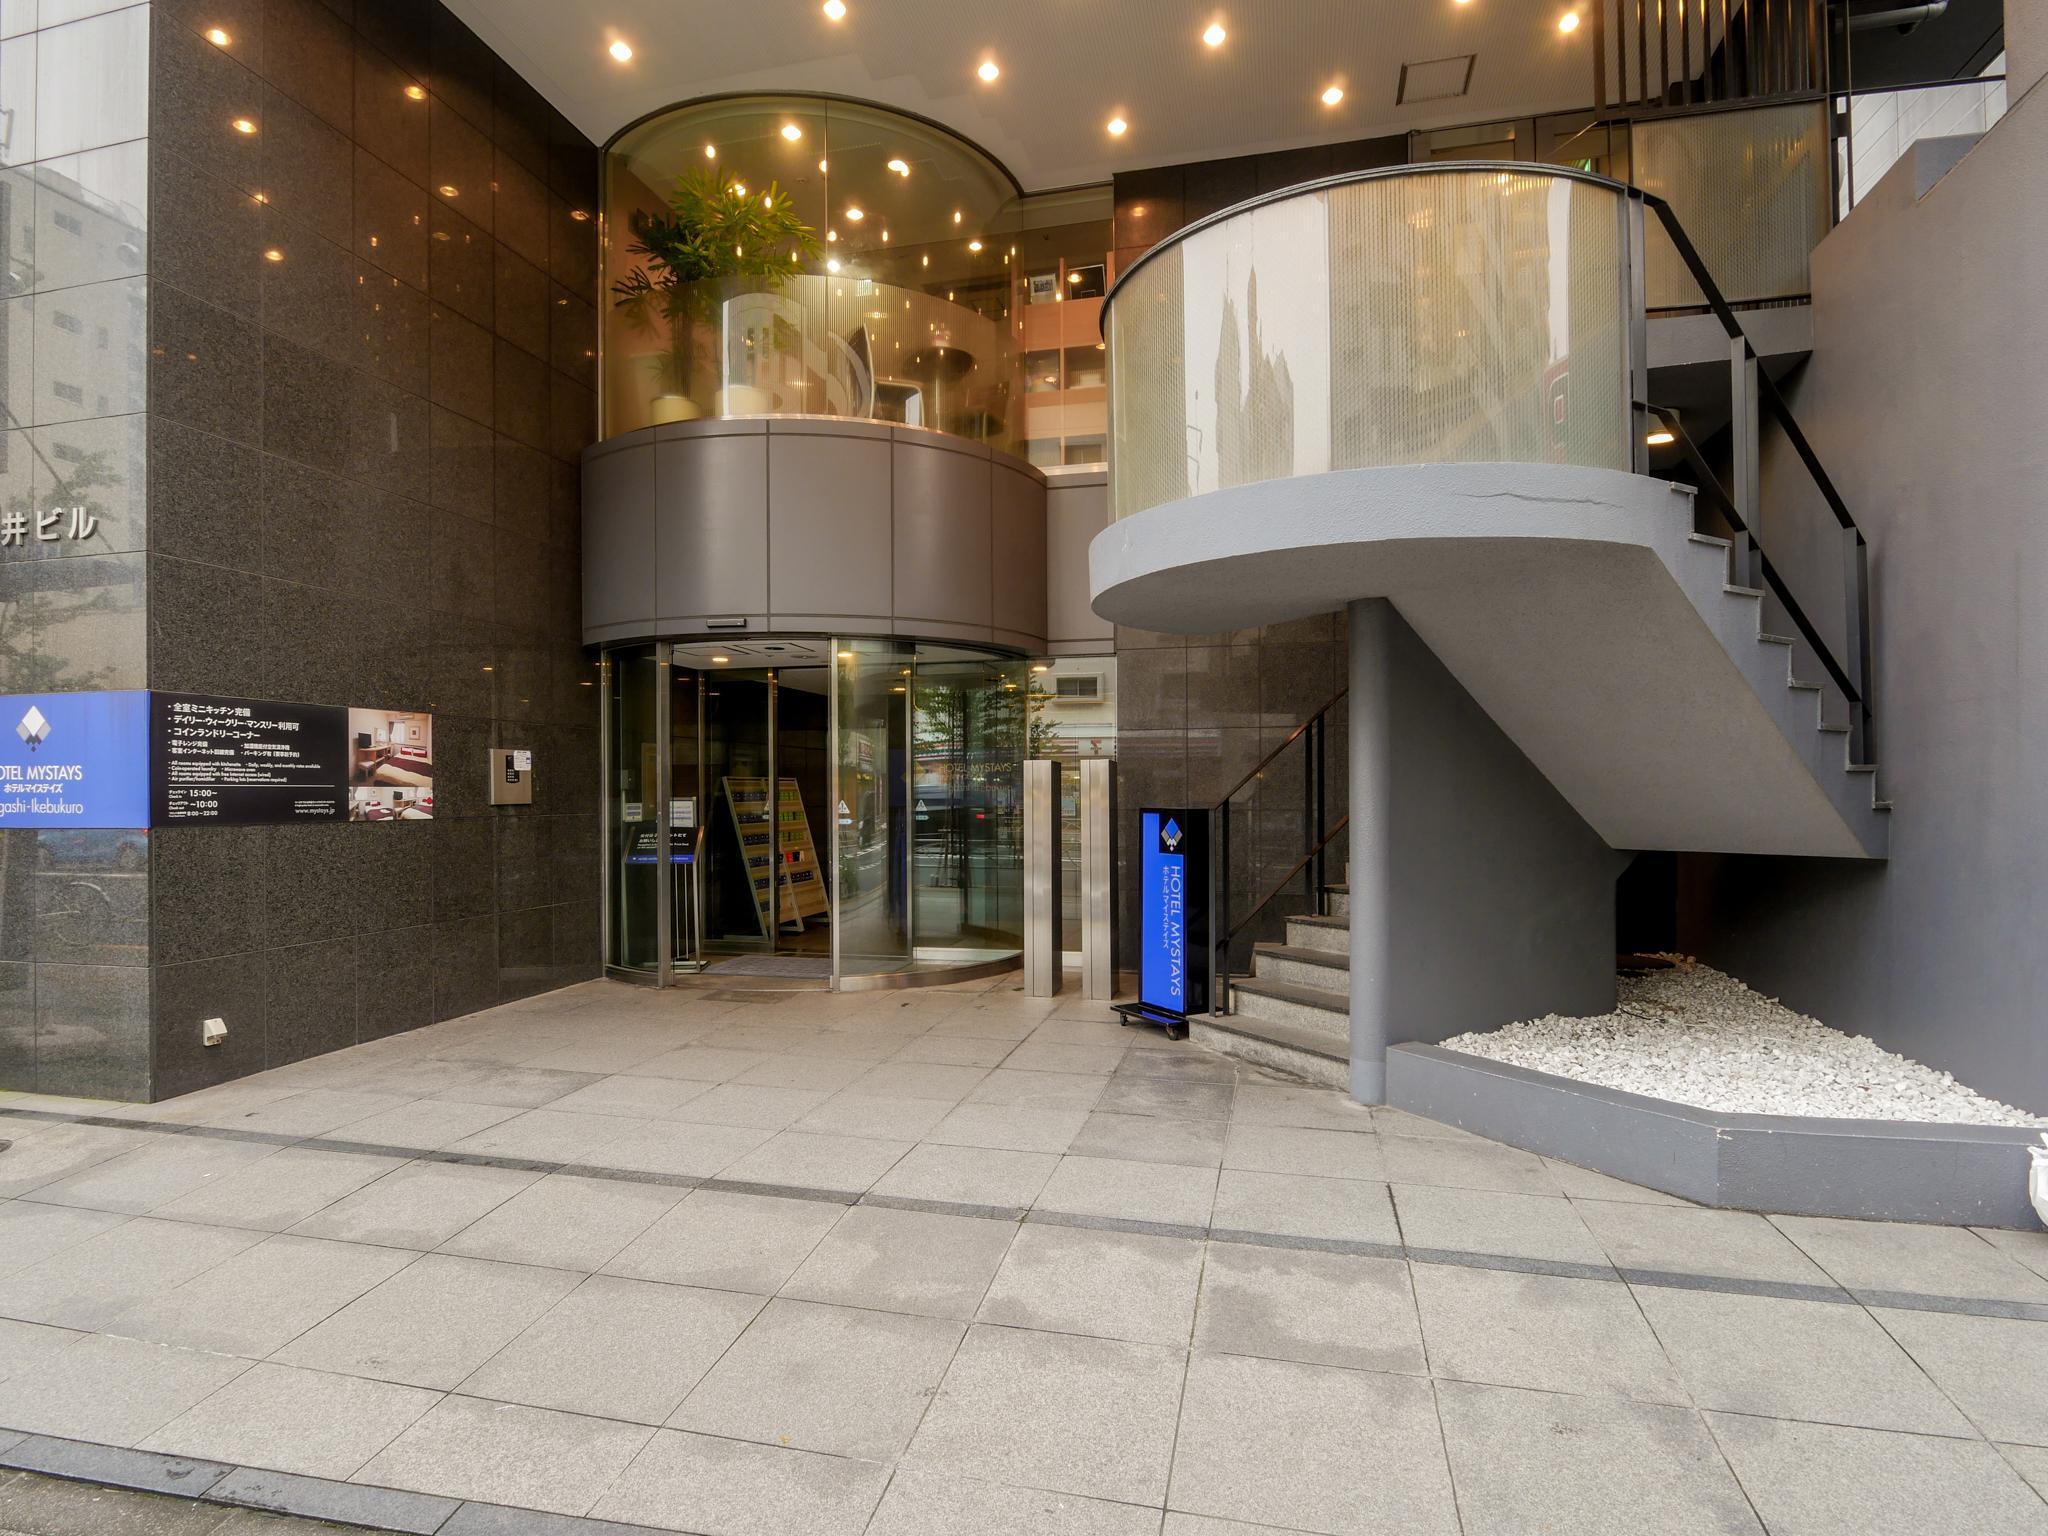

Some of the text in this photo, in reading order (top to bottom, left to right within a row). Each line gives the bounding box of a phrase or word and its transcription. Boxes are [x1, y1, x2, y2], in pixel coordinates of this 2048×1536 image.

[173, 728, 261, 739] コインランドリーコーナー
[26, 765, 82, 780] MYSTAYS
[3, 783, 63, 793] ホテルマイステイズ
[1170, 865, 1181, 997] HOTEL MYSTAYS
